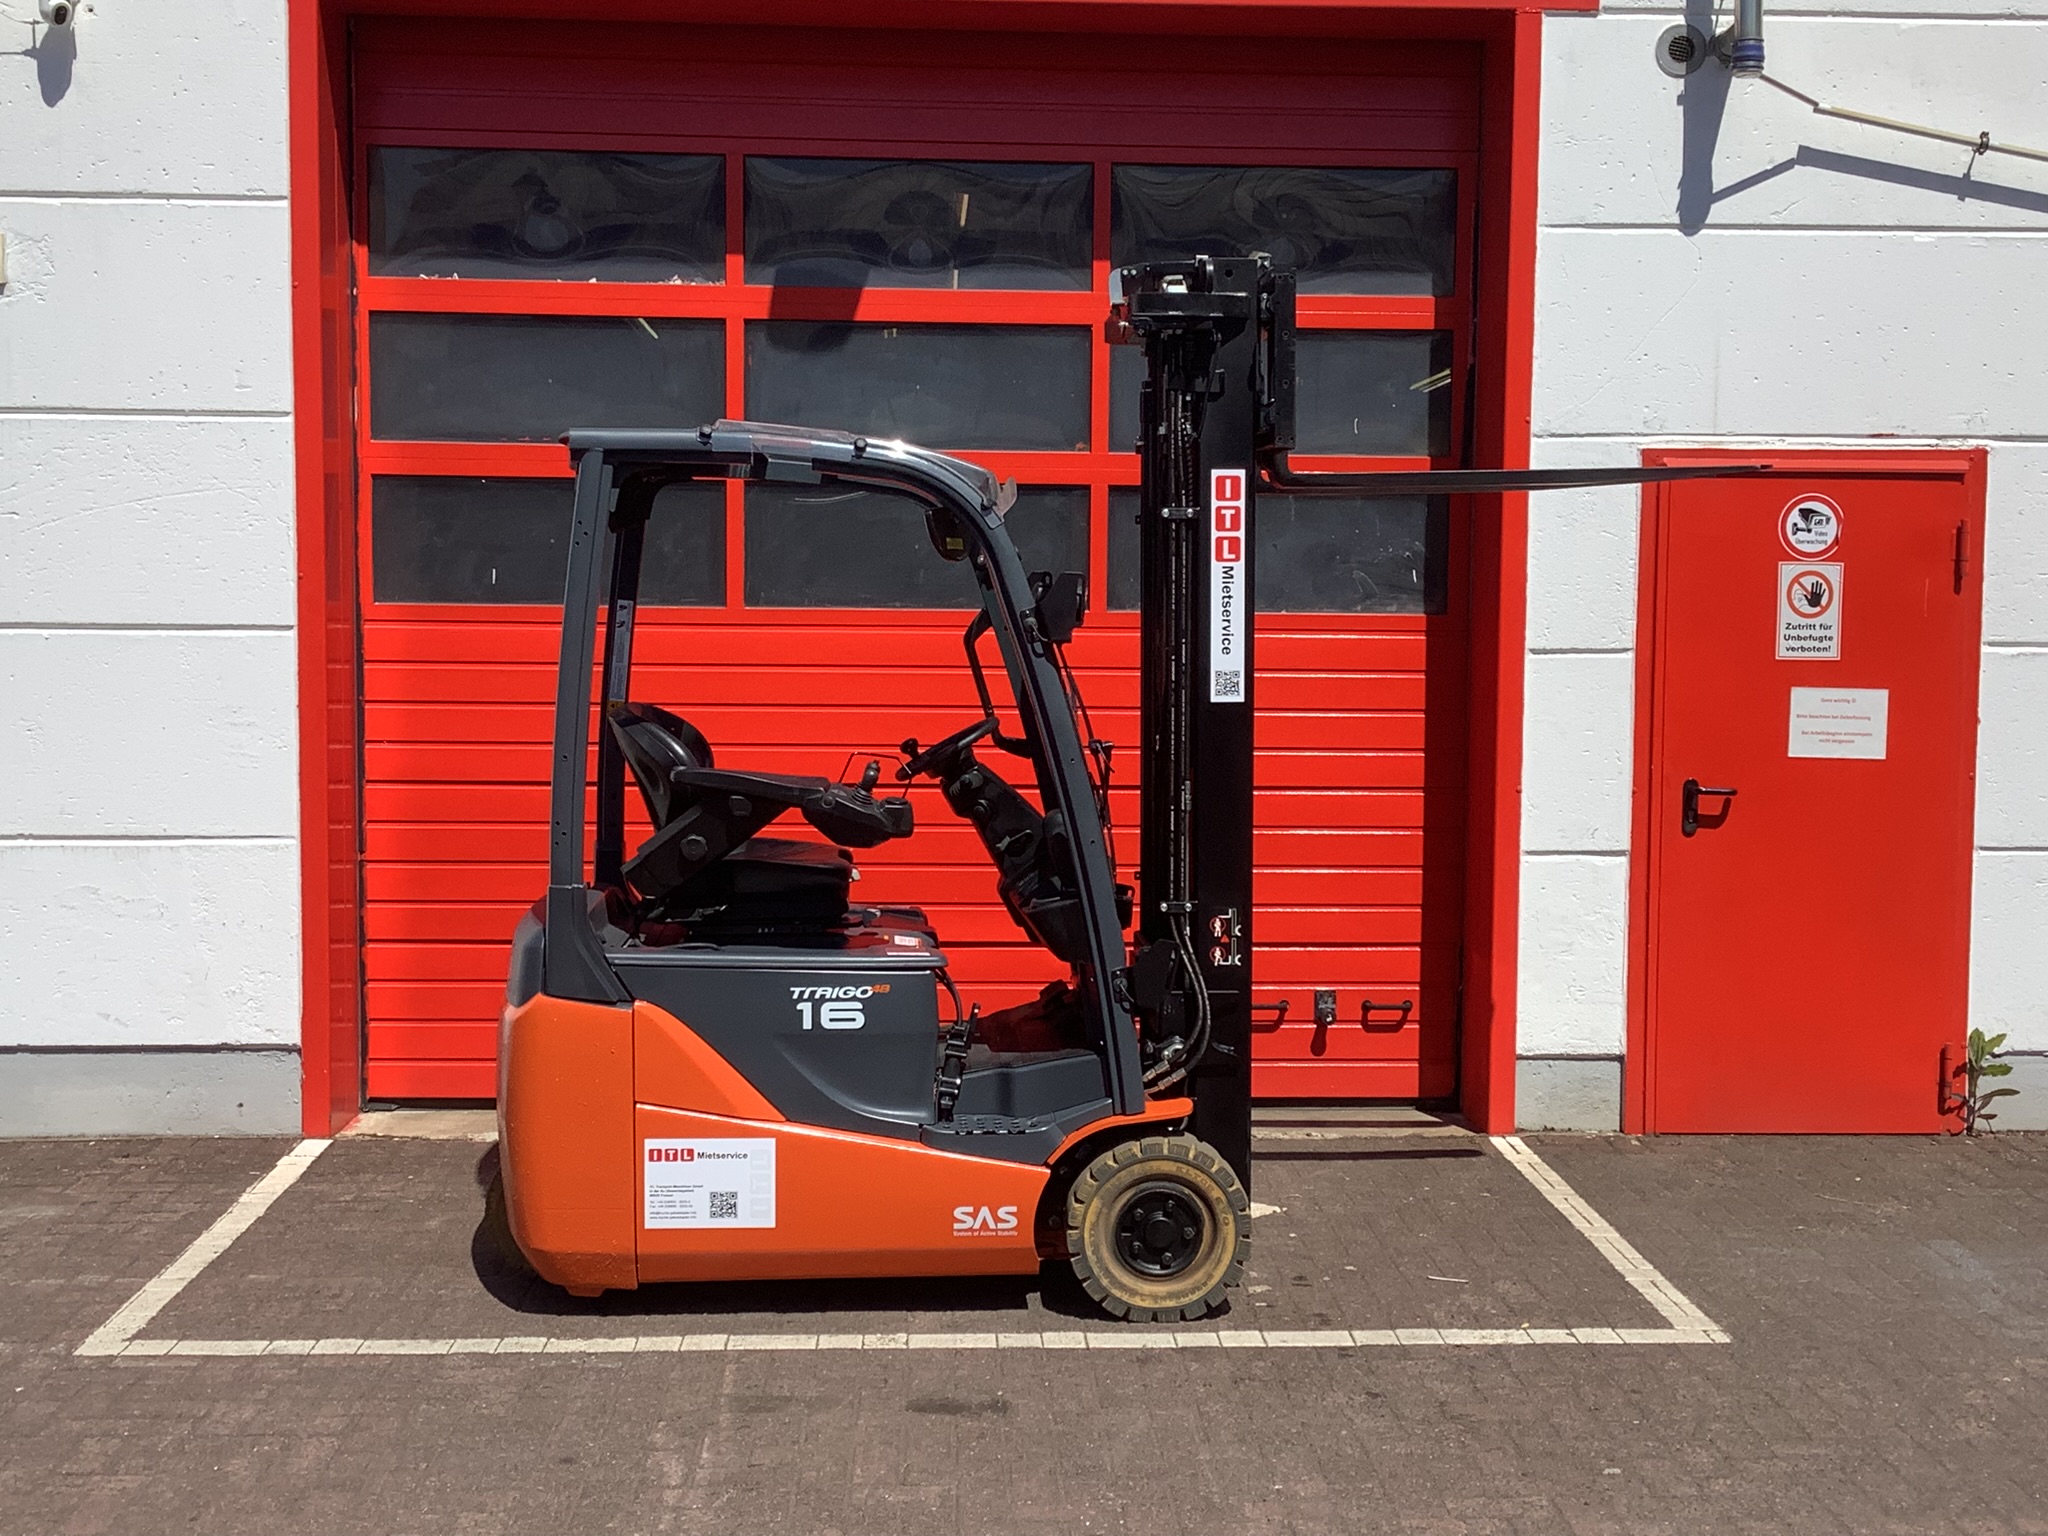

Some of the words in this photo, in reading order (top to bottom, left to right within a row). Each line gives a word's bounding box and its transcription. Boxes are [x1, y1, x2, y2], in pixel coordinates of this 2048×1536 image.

[1218, 478, 1239, 561] ITL
[1220, 565, 1235, 656] Mietservice
[1784, 622, 1817, 631] Zutritt
[1819, 621, 1833, 631] für
[1783, 634, 1834, 644] Unbefugte
[1785, 645, 1831, 653] verboten!
[796, 1001, 865, 1030] 16
[650, 1149, 693, 1162] ITL
[697, 1151, 748, 1160] Mietservice
[953, 1206, 1018, 1230] SAS
